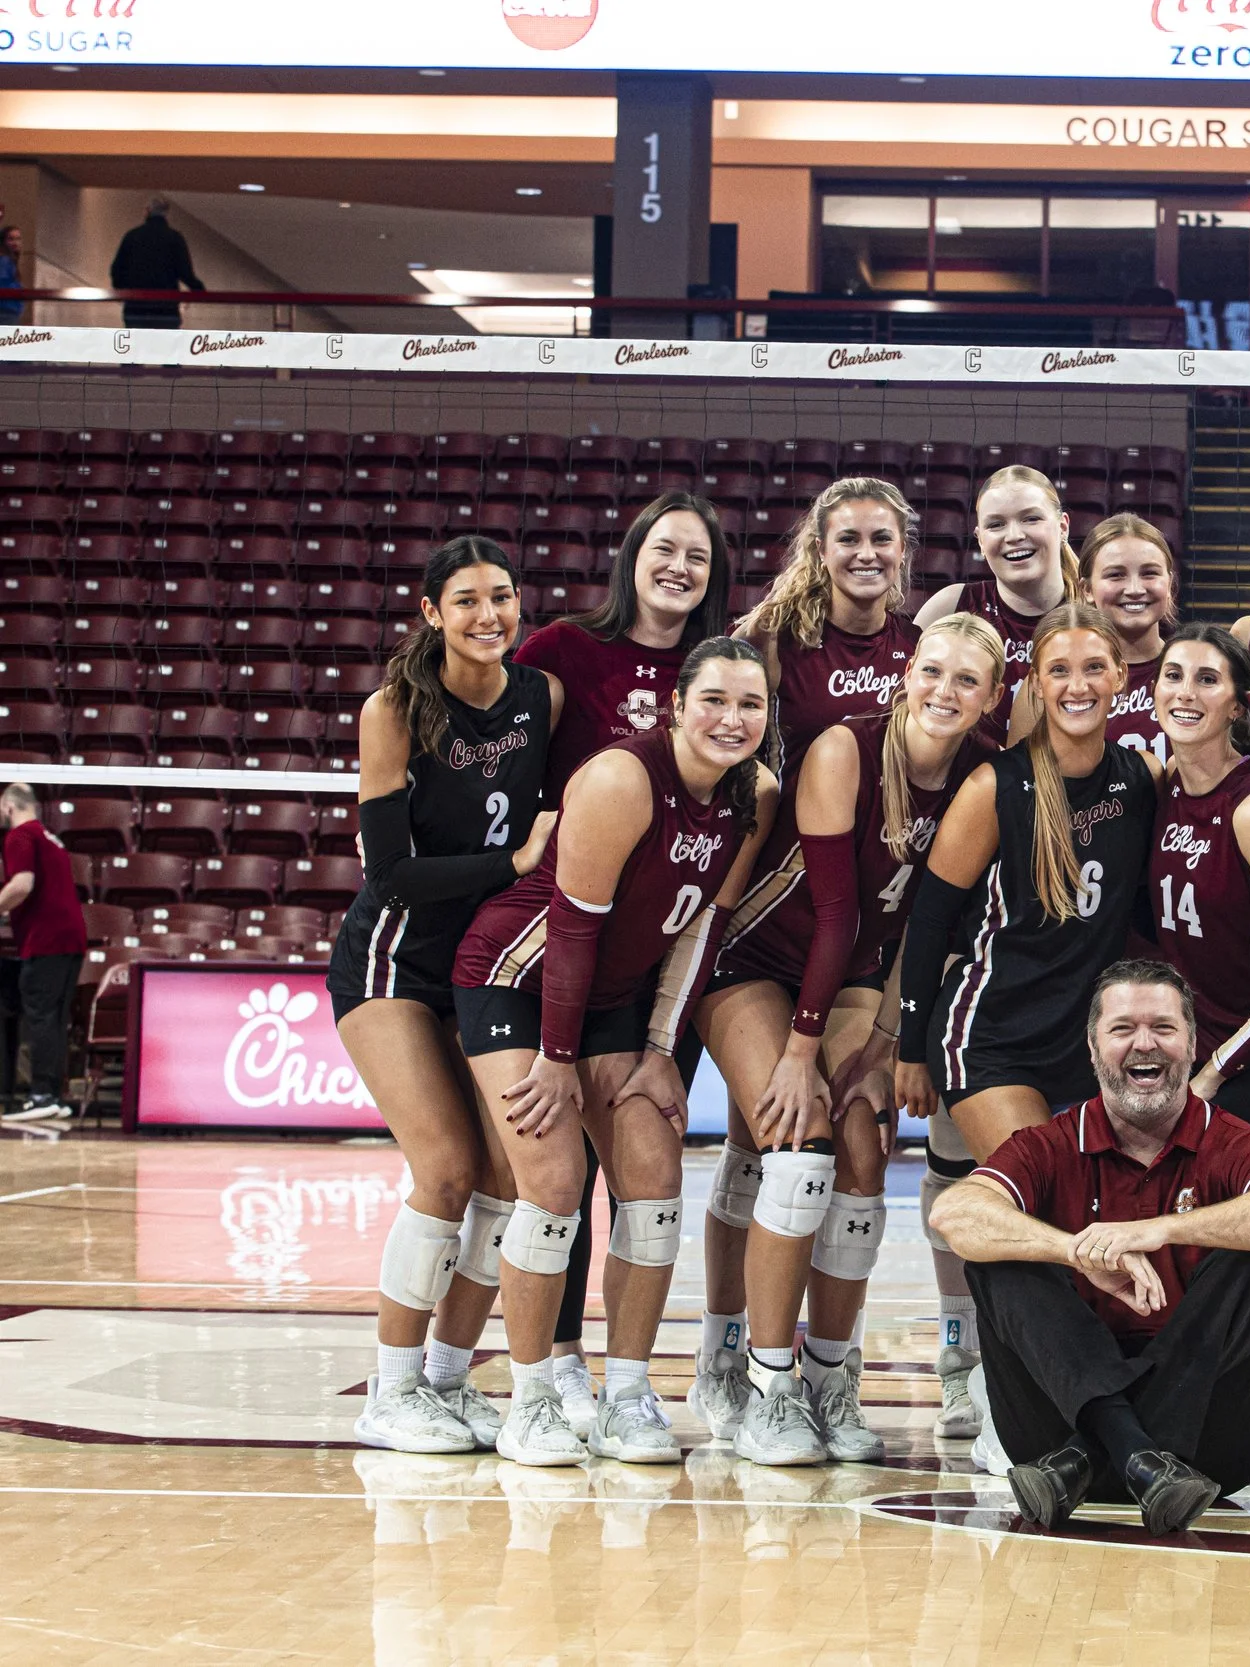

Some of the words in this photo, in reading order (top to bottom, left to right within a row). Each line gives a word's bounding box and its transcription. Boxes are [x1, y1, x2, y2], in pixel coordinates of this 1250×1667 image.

[27, 30, 134, 52] SUGAR
[1066, 117, 1227, 147] COUGAR
[640, 132, 662, 224] 115
[190, 333, 264, 355] Charleston
[402, 338, 477, 360] Charleston
[615, 342, 689, 365] Charleston
[828, 347, 903, 369] Charleston
[1041, 350, 1116, 374] Charleston
[892, 651, 905, 660] CAA
[828, 665, 900, 705] College
[449, 728, 528, 778] Cougars
[1109, 782, 1127, 793] CAA
[484, 790, 510, 847] 2
[1070, 798, 1124, 846] ugars
[661, 884, 703, 935] 0
[878, 864, 914, 913] 4
[1076, 860, 1104, 918] 6
[1160, 874, 1203, 938] 14
